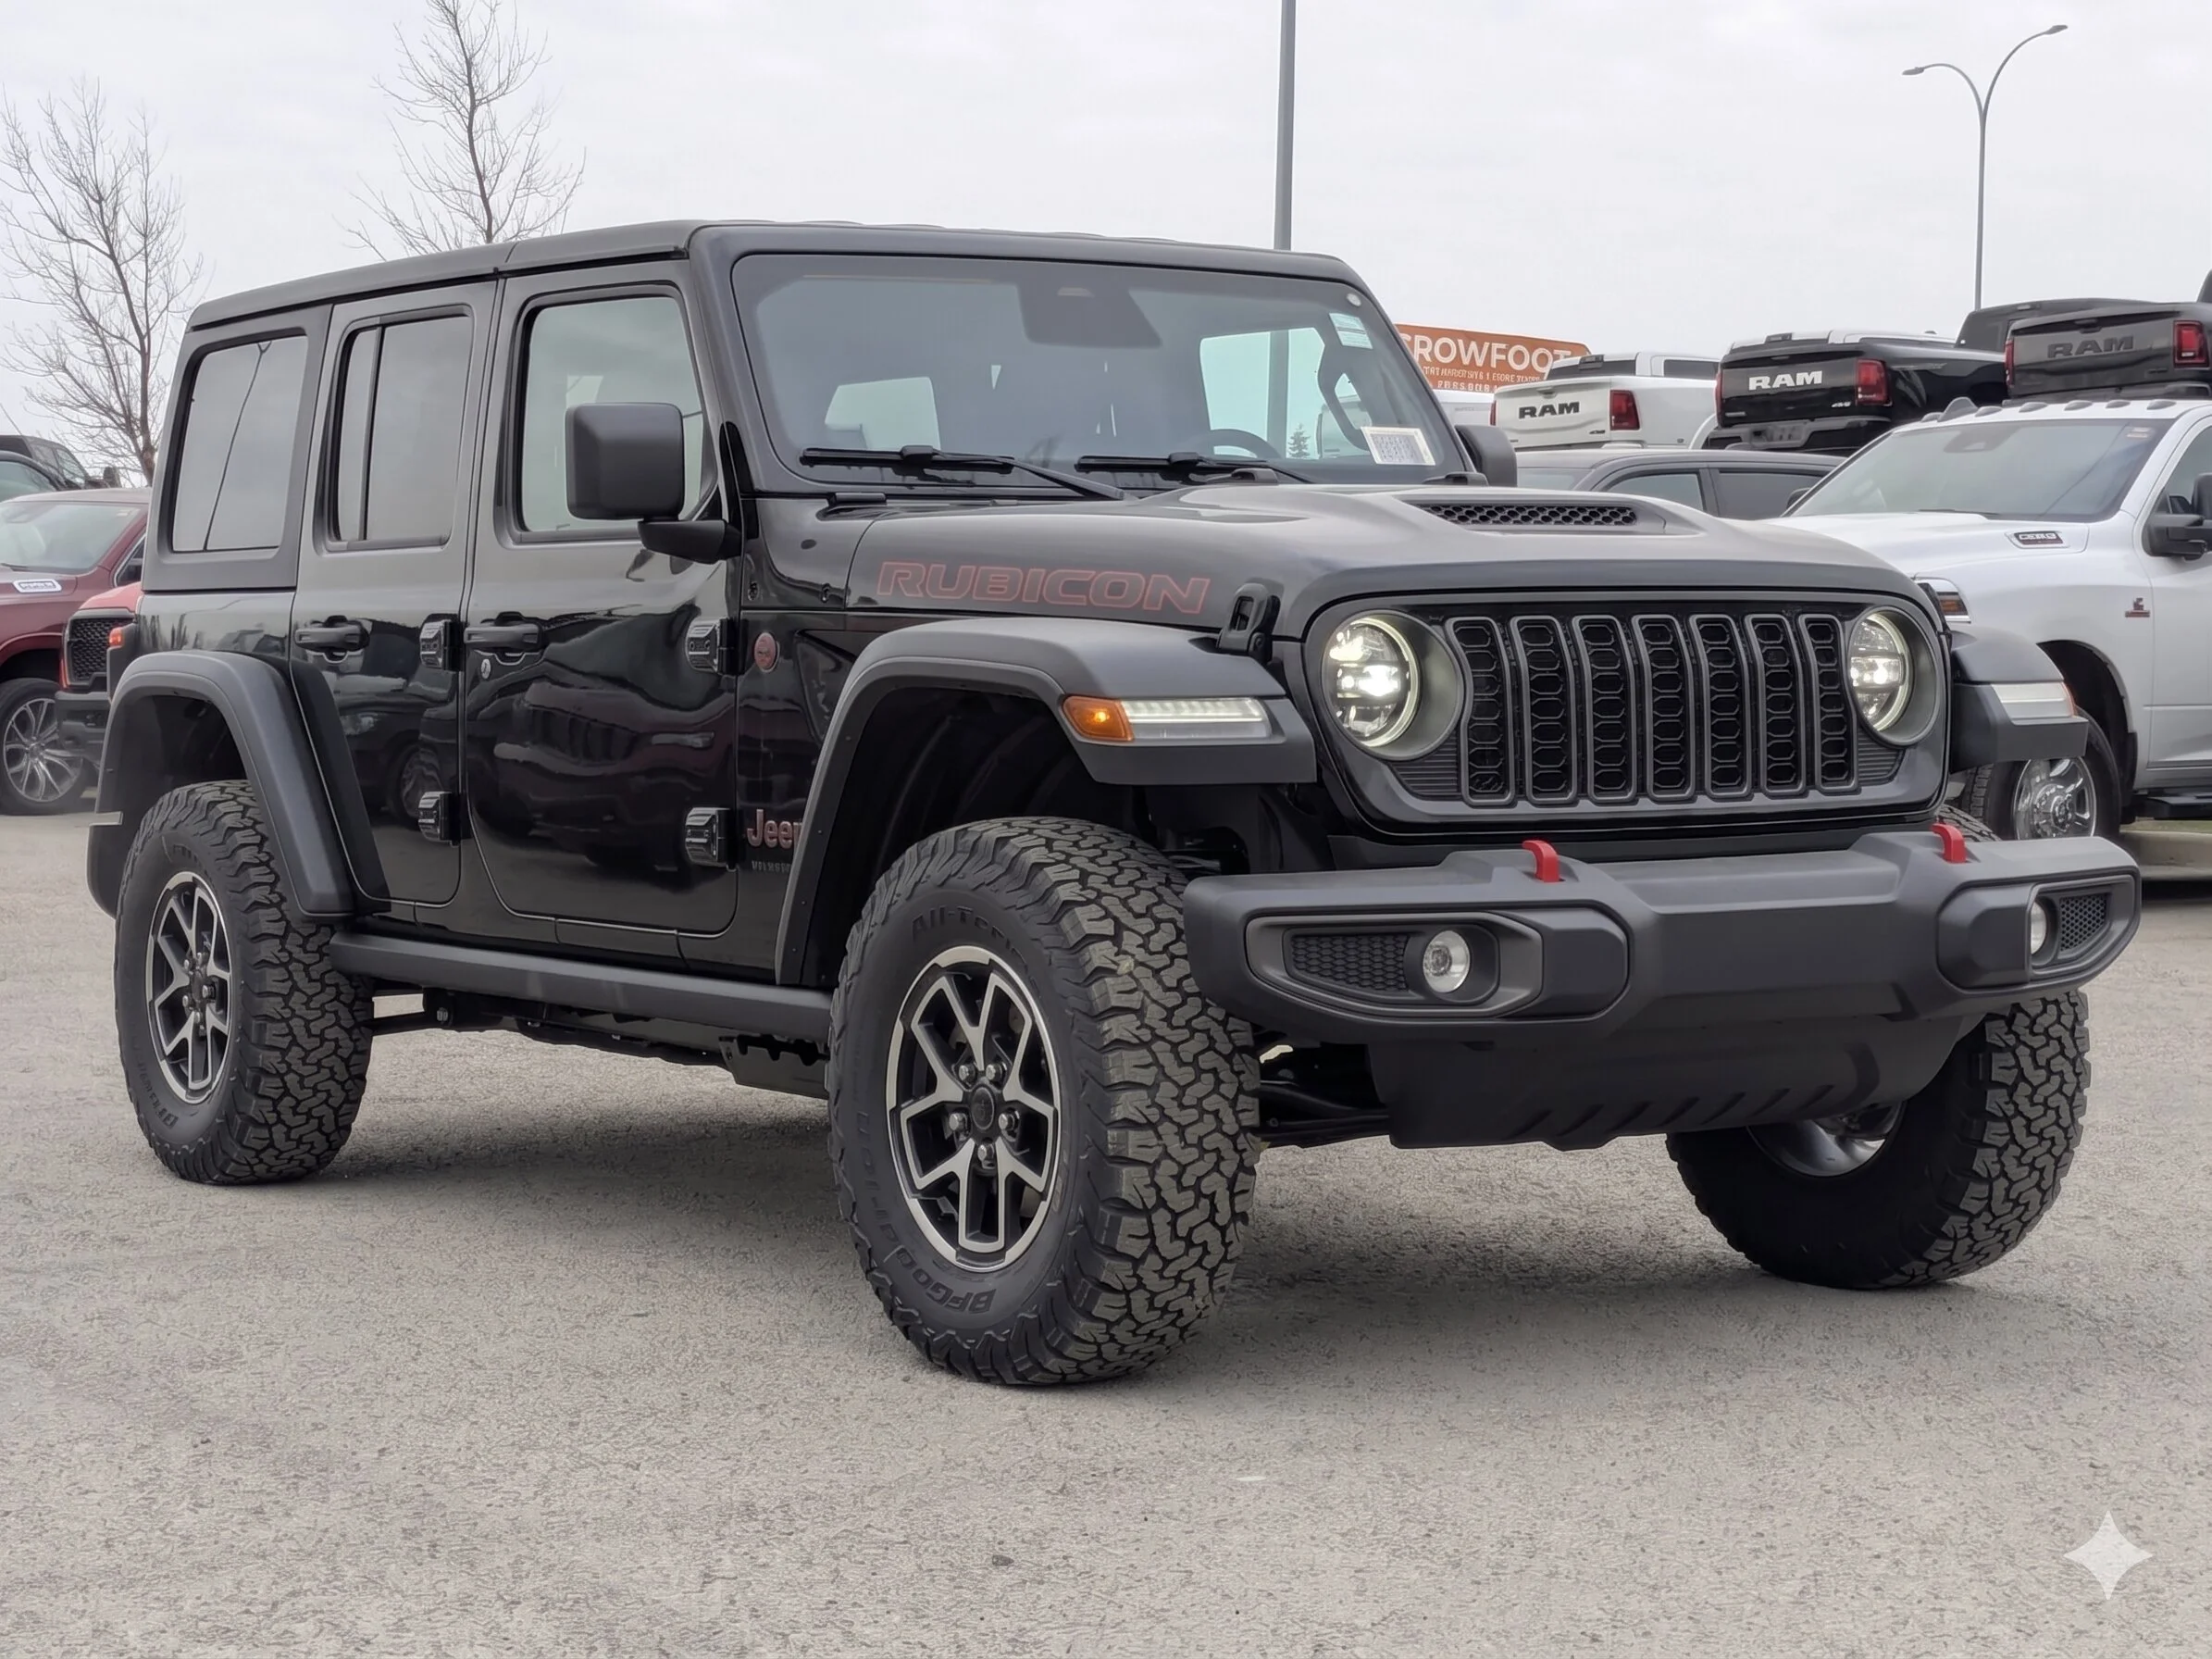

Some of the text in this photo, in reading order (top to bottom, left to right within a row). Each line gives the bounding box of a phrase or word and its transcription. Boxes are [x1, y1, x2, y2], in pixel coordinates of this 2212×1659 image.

[1399, 333, 1572, 374] ROWFOOT
[2047, 336, 2134, 359] RAM
[1748, 370, 1823, 391] RAM
[1519, 402, 1580, 419] RAM
[876, 561, 1211, 614] RUBICON
